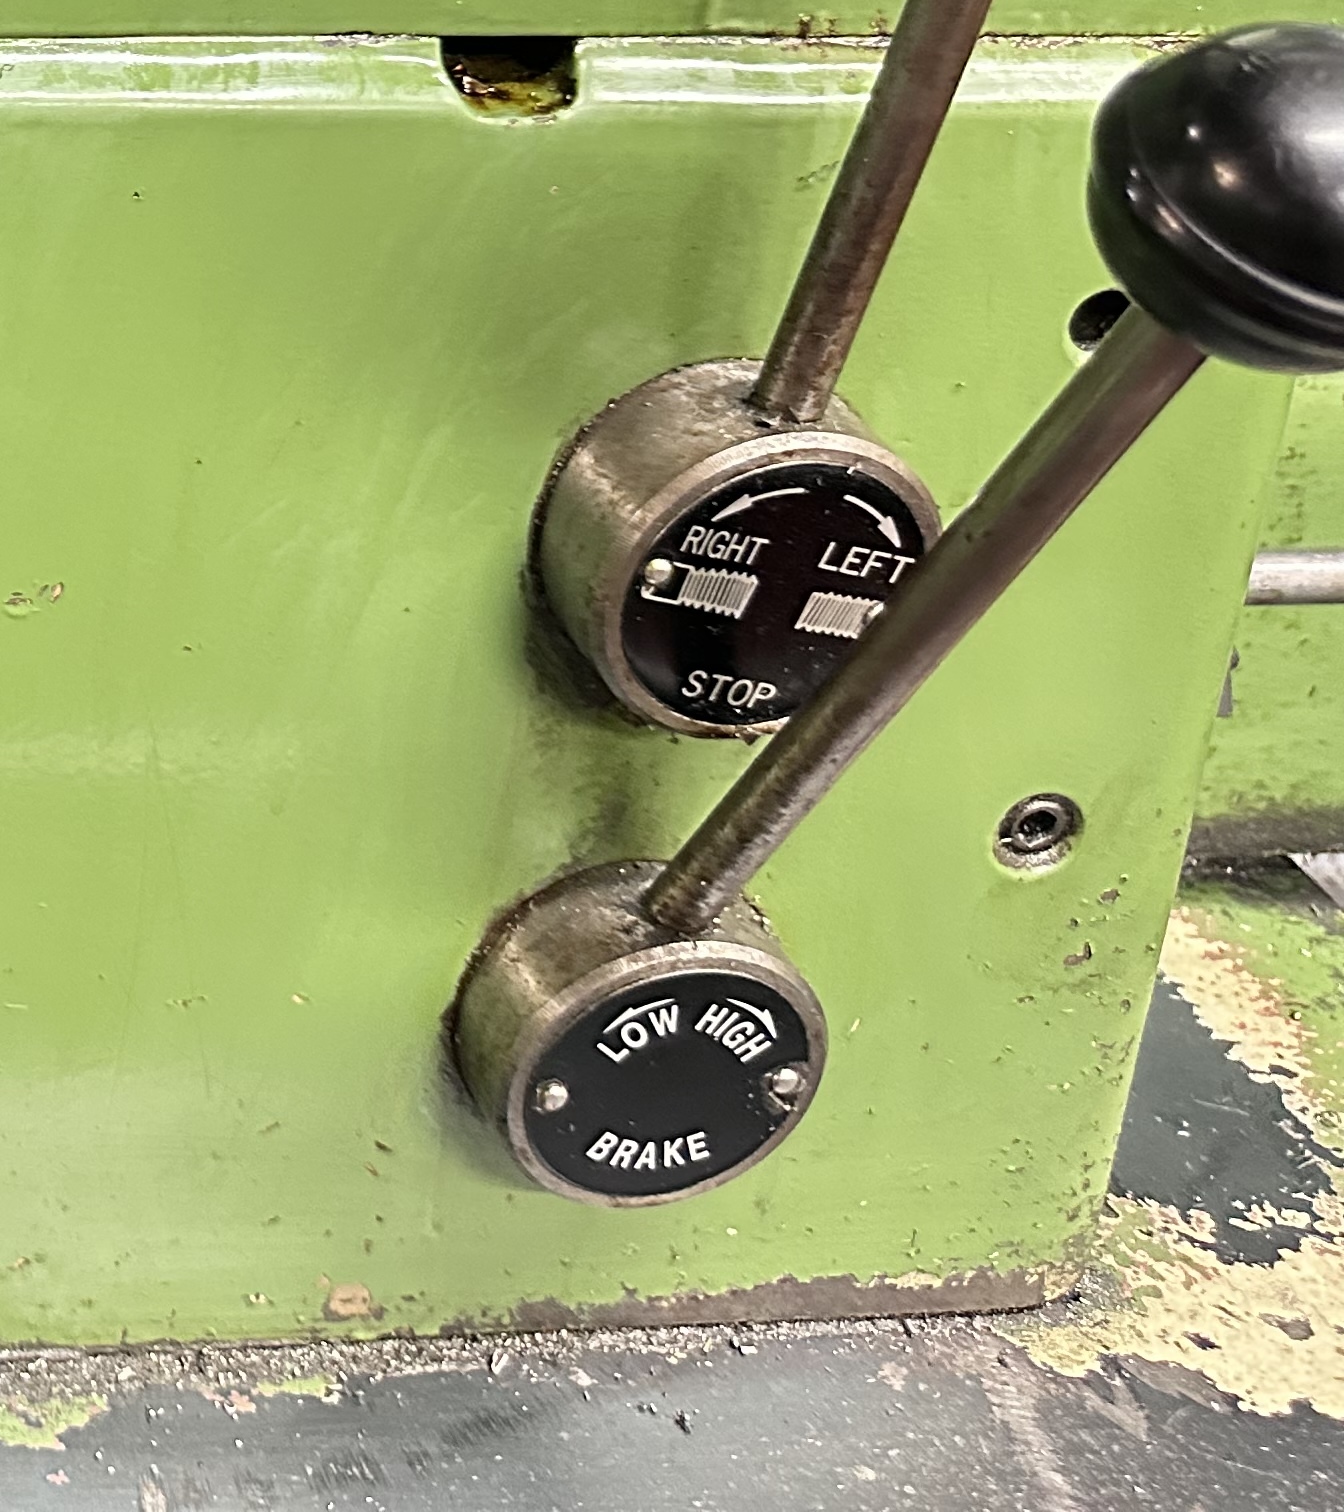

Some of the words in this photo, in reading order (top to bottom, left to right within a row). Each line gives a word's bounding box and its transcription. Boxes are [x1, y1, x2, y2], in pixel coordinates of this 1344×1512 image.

[679, 525, 770, 565] RIGHT
[817, 541, 915, 583] LEFT
[681, 670, 777, 708] STOP
[596, 1004, 679, 1063] LOW
[694, 1004, 774, 1063] HIGH
[586, 1130, 711, 1170] BRAKE
